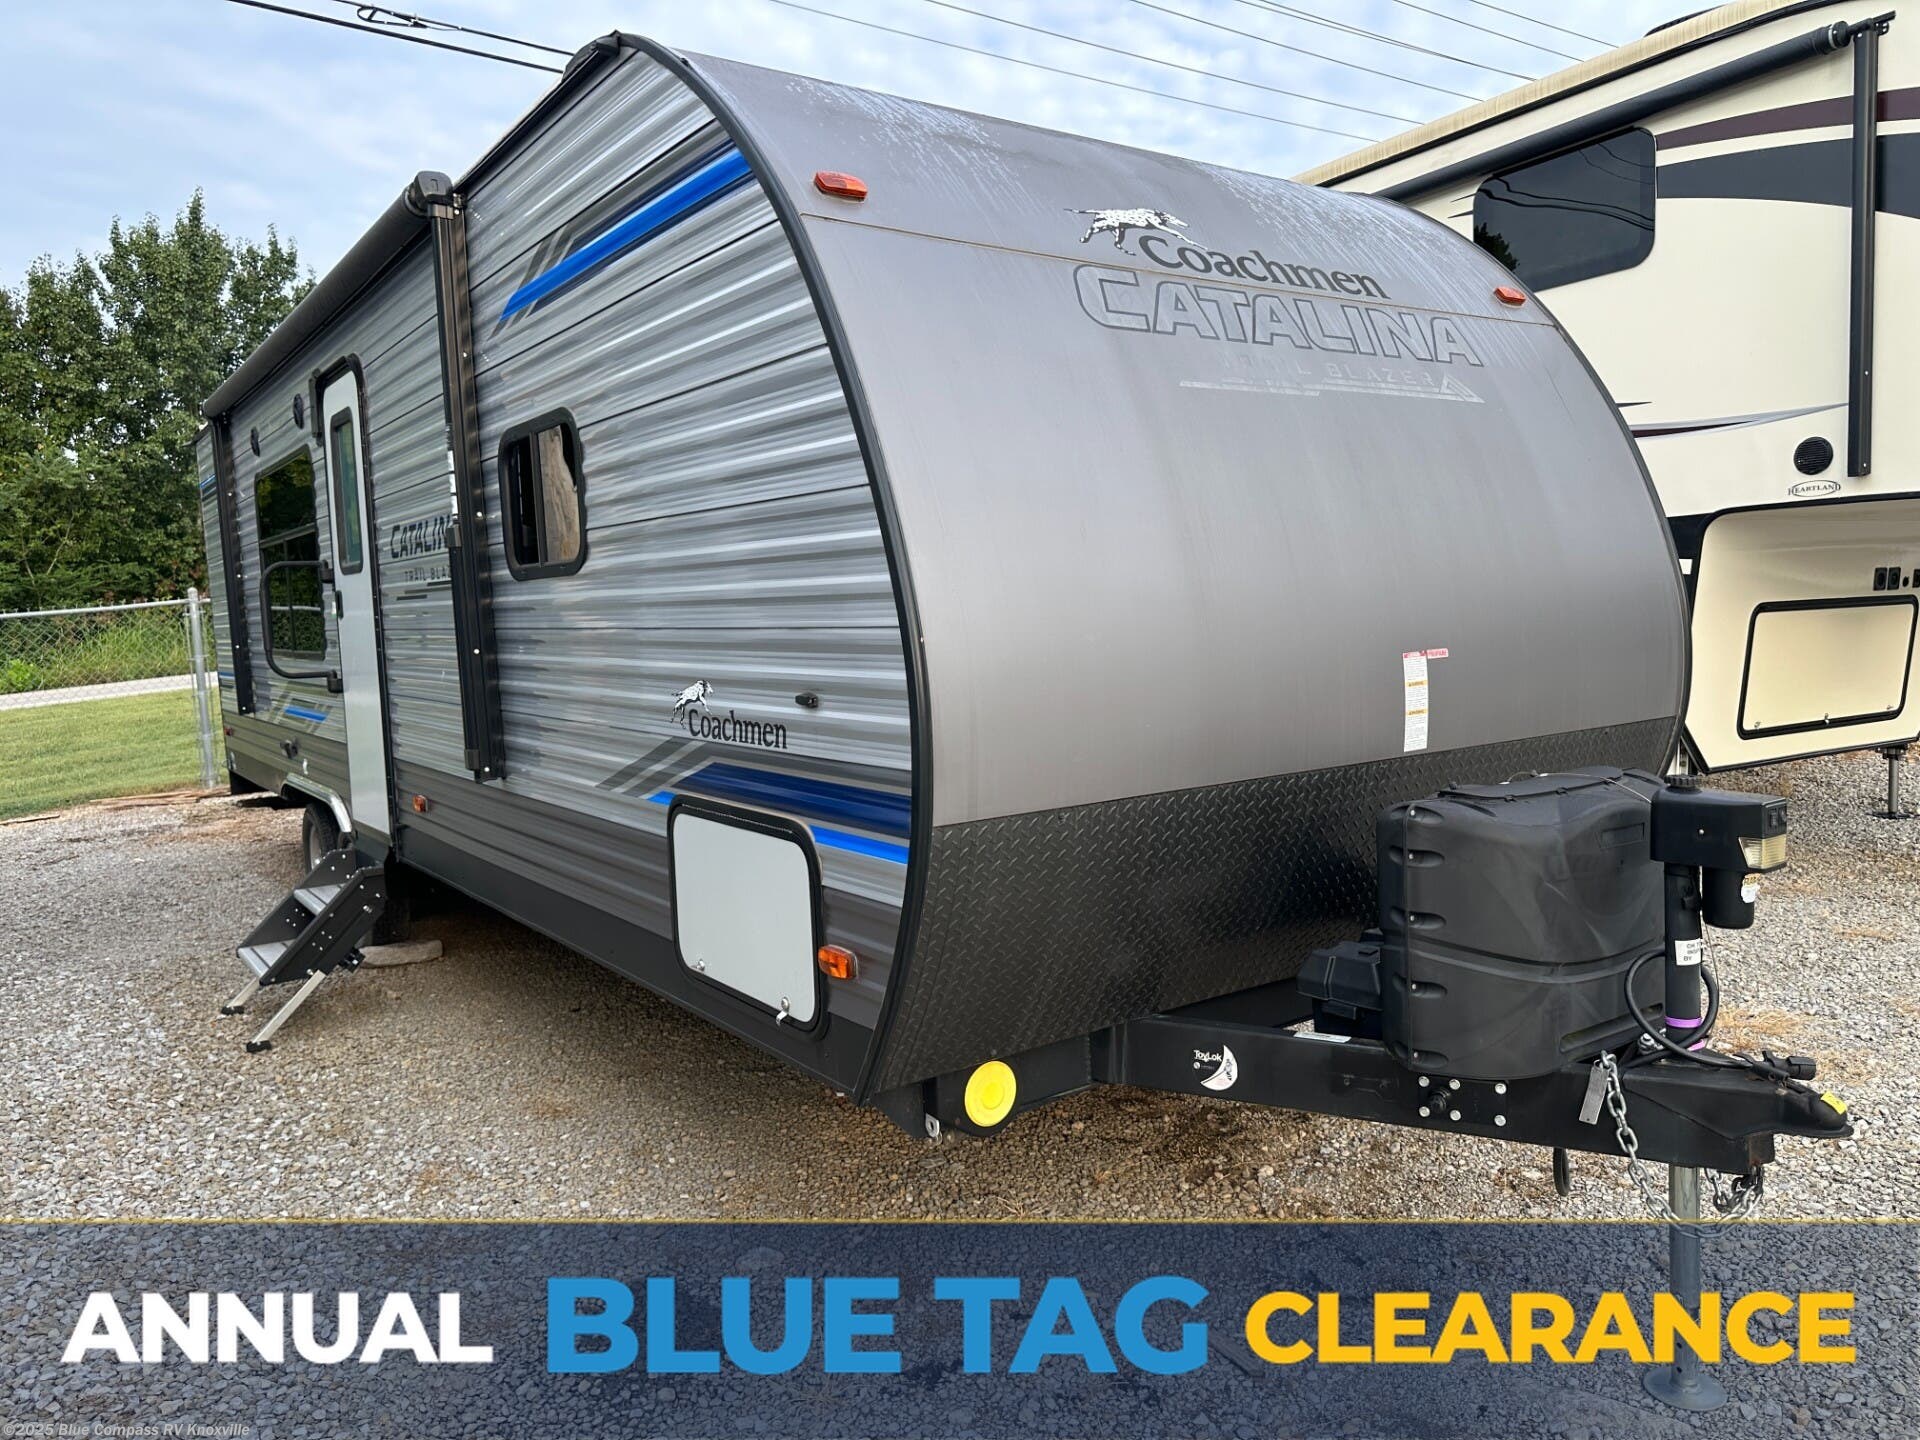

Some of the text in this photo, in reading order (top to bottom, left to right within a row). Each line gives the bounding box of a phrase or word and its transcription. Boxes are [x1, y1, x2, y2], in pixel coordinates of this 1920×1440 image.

[1139, 235, 1391, 300] Coachmen
[1073, 264, 1484, 368] CATALINA
[1788, 482, 1841, 496] HEARTLAND
[390, 514, 450, 559] CATALIN
[404, 568, 427, 582] TRAIL
[688, 709, 788, 749] Coachmen
